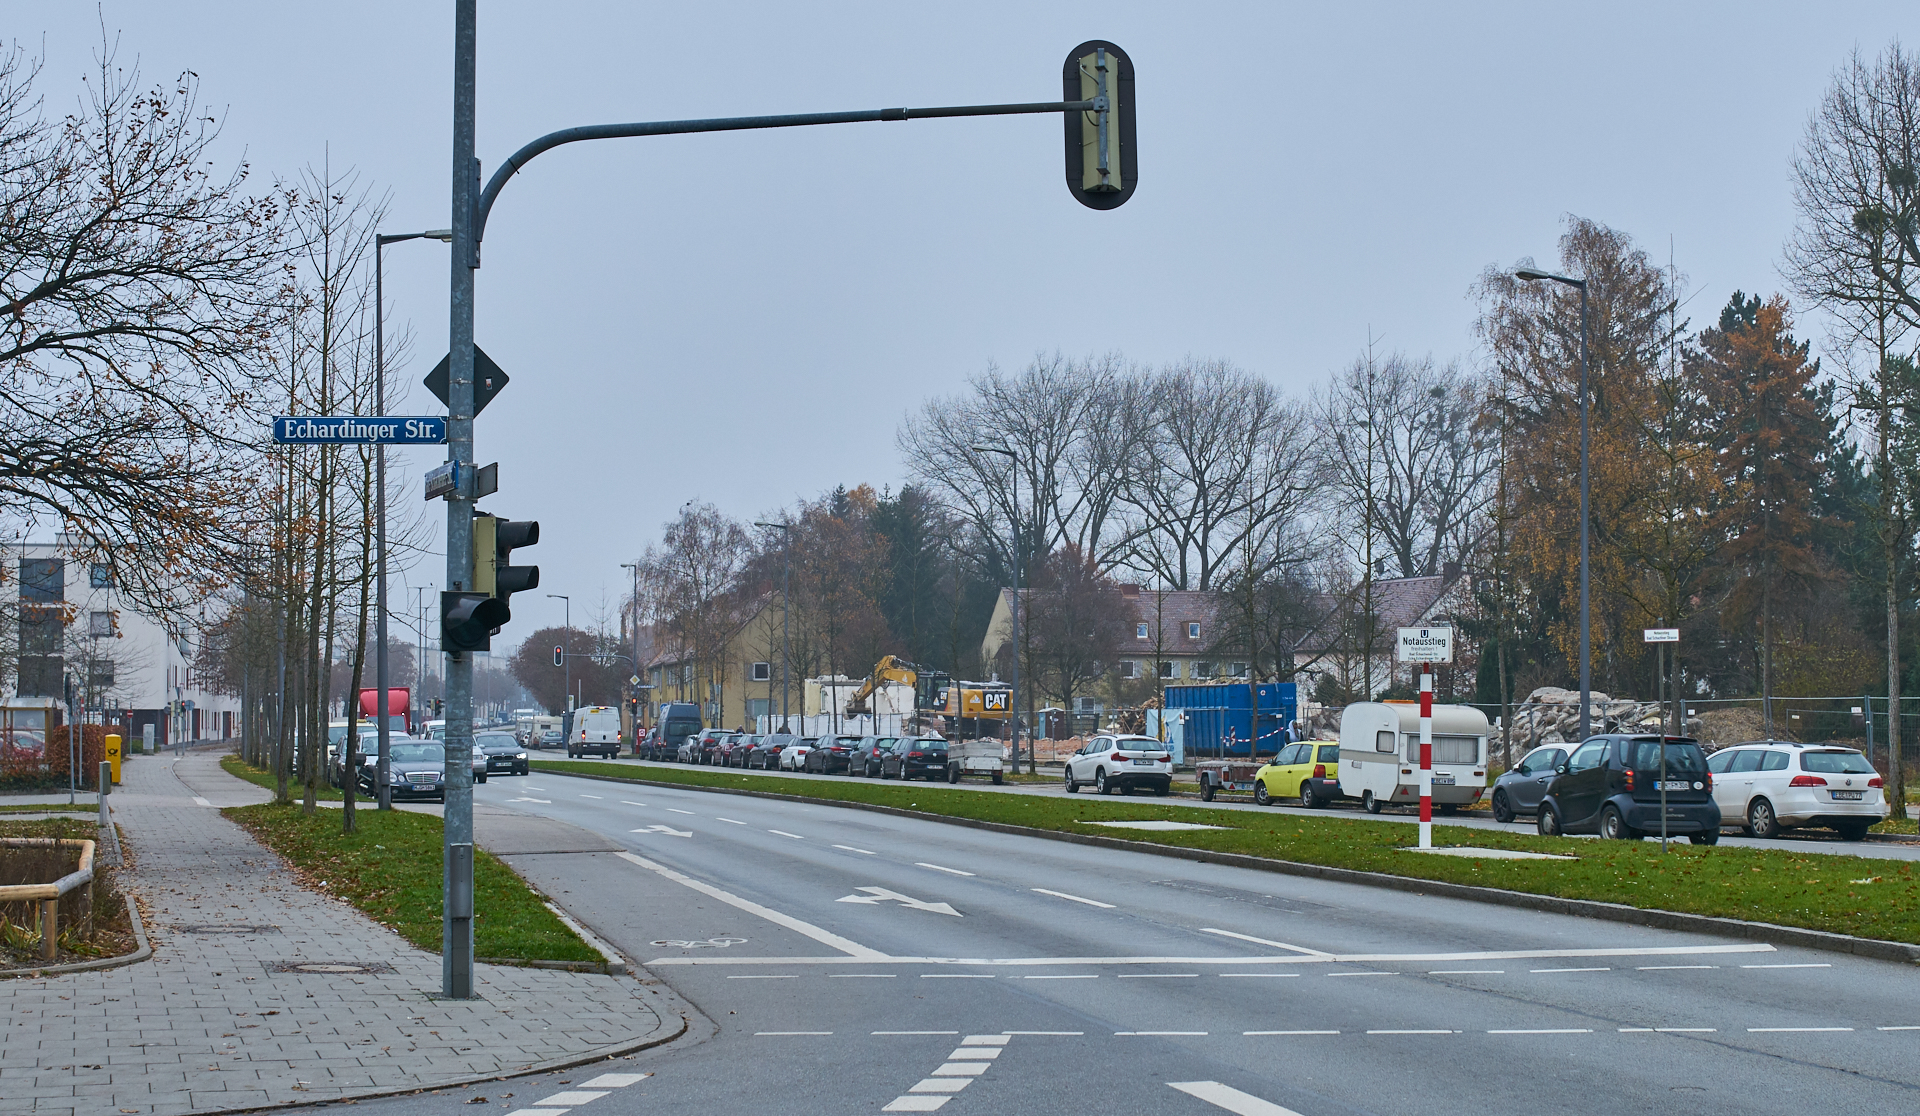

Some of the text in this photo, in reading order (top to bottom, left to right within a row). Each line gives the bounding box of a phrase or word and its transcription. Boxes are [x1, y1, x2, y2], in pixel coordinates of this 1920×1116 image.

[284, 419, 437, 442] Echardinger Str.
[1403, 637, 1446, 647] Notausstieg
[985, 694, 1007, 709] CAT
